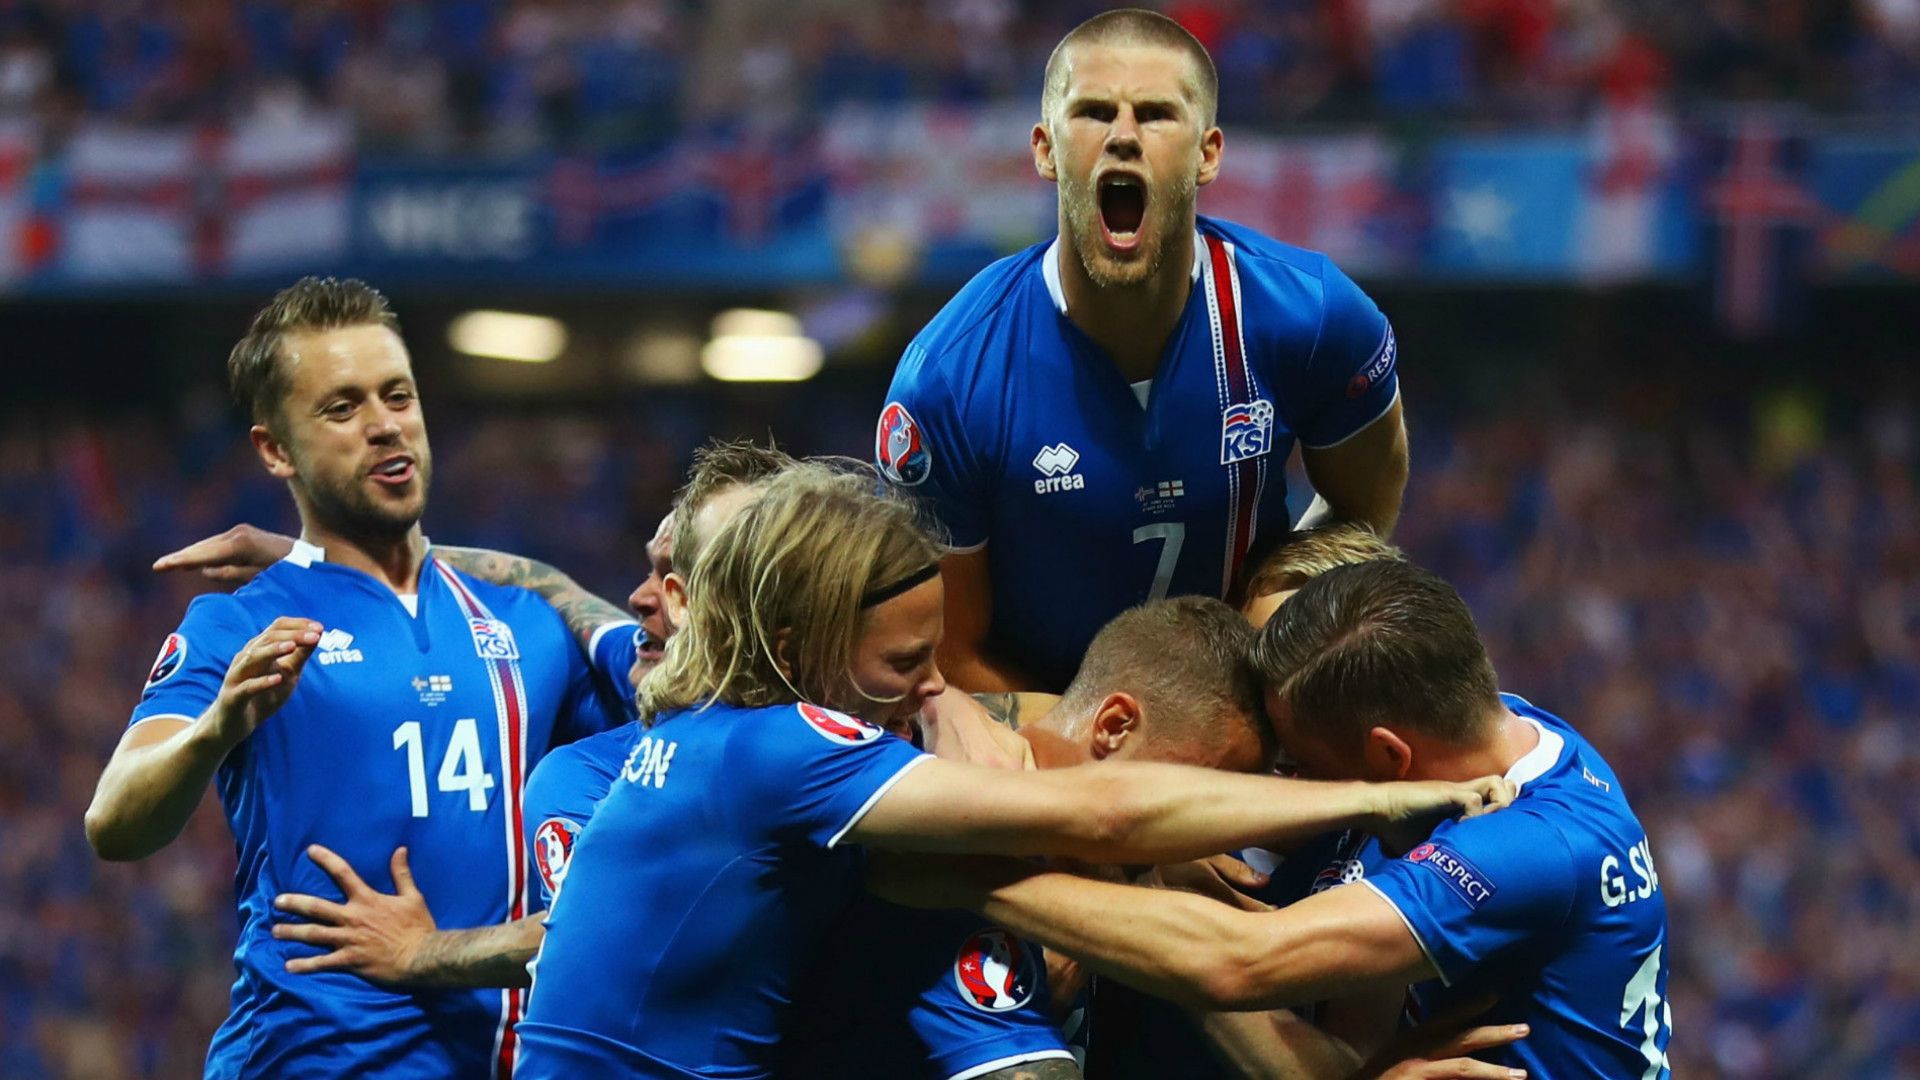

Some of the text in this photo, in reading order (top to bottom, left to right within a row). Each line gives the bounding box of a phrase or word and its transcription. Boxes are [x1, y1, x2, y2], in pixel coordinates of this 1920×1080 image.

[1223, 425, 1271, 462] KSI
[1035, 474, 1084, 494] errea
[1133, 523, 1185, 604] 7
[318, 649, 363, 665] errea
[393, 719, 494, 817] 14
[1428, 851, 1490, 902] RESPECT
[1620, 944, 1672, 1080] 1
